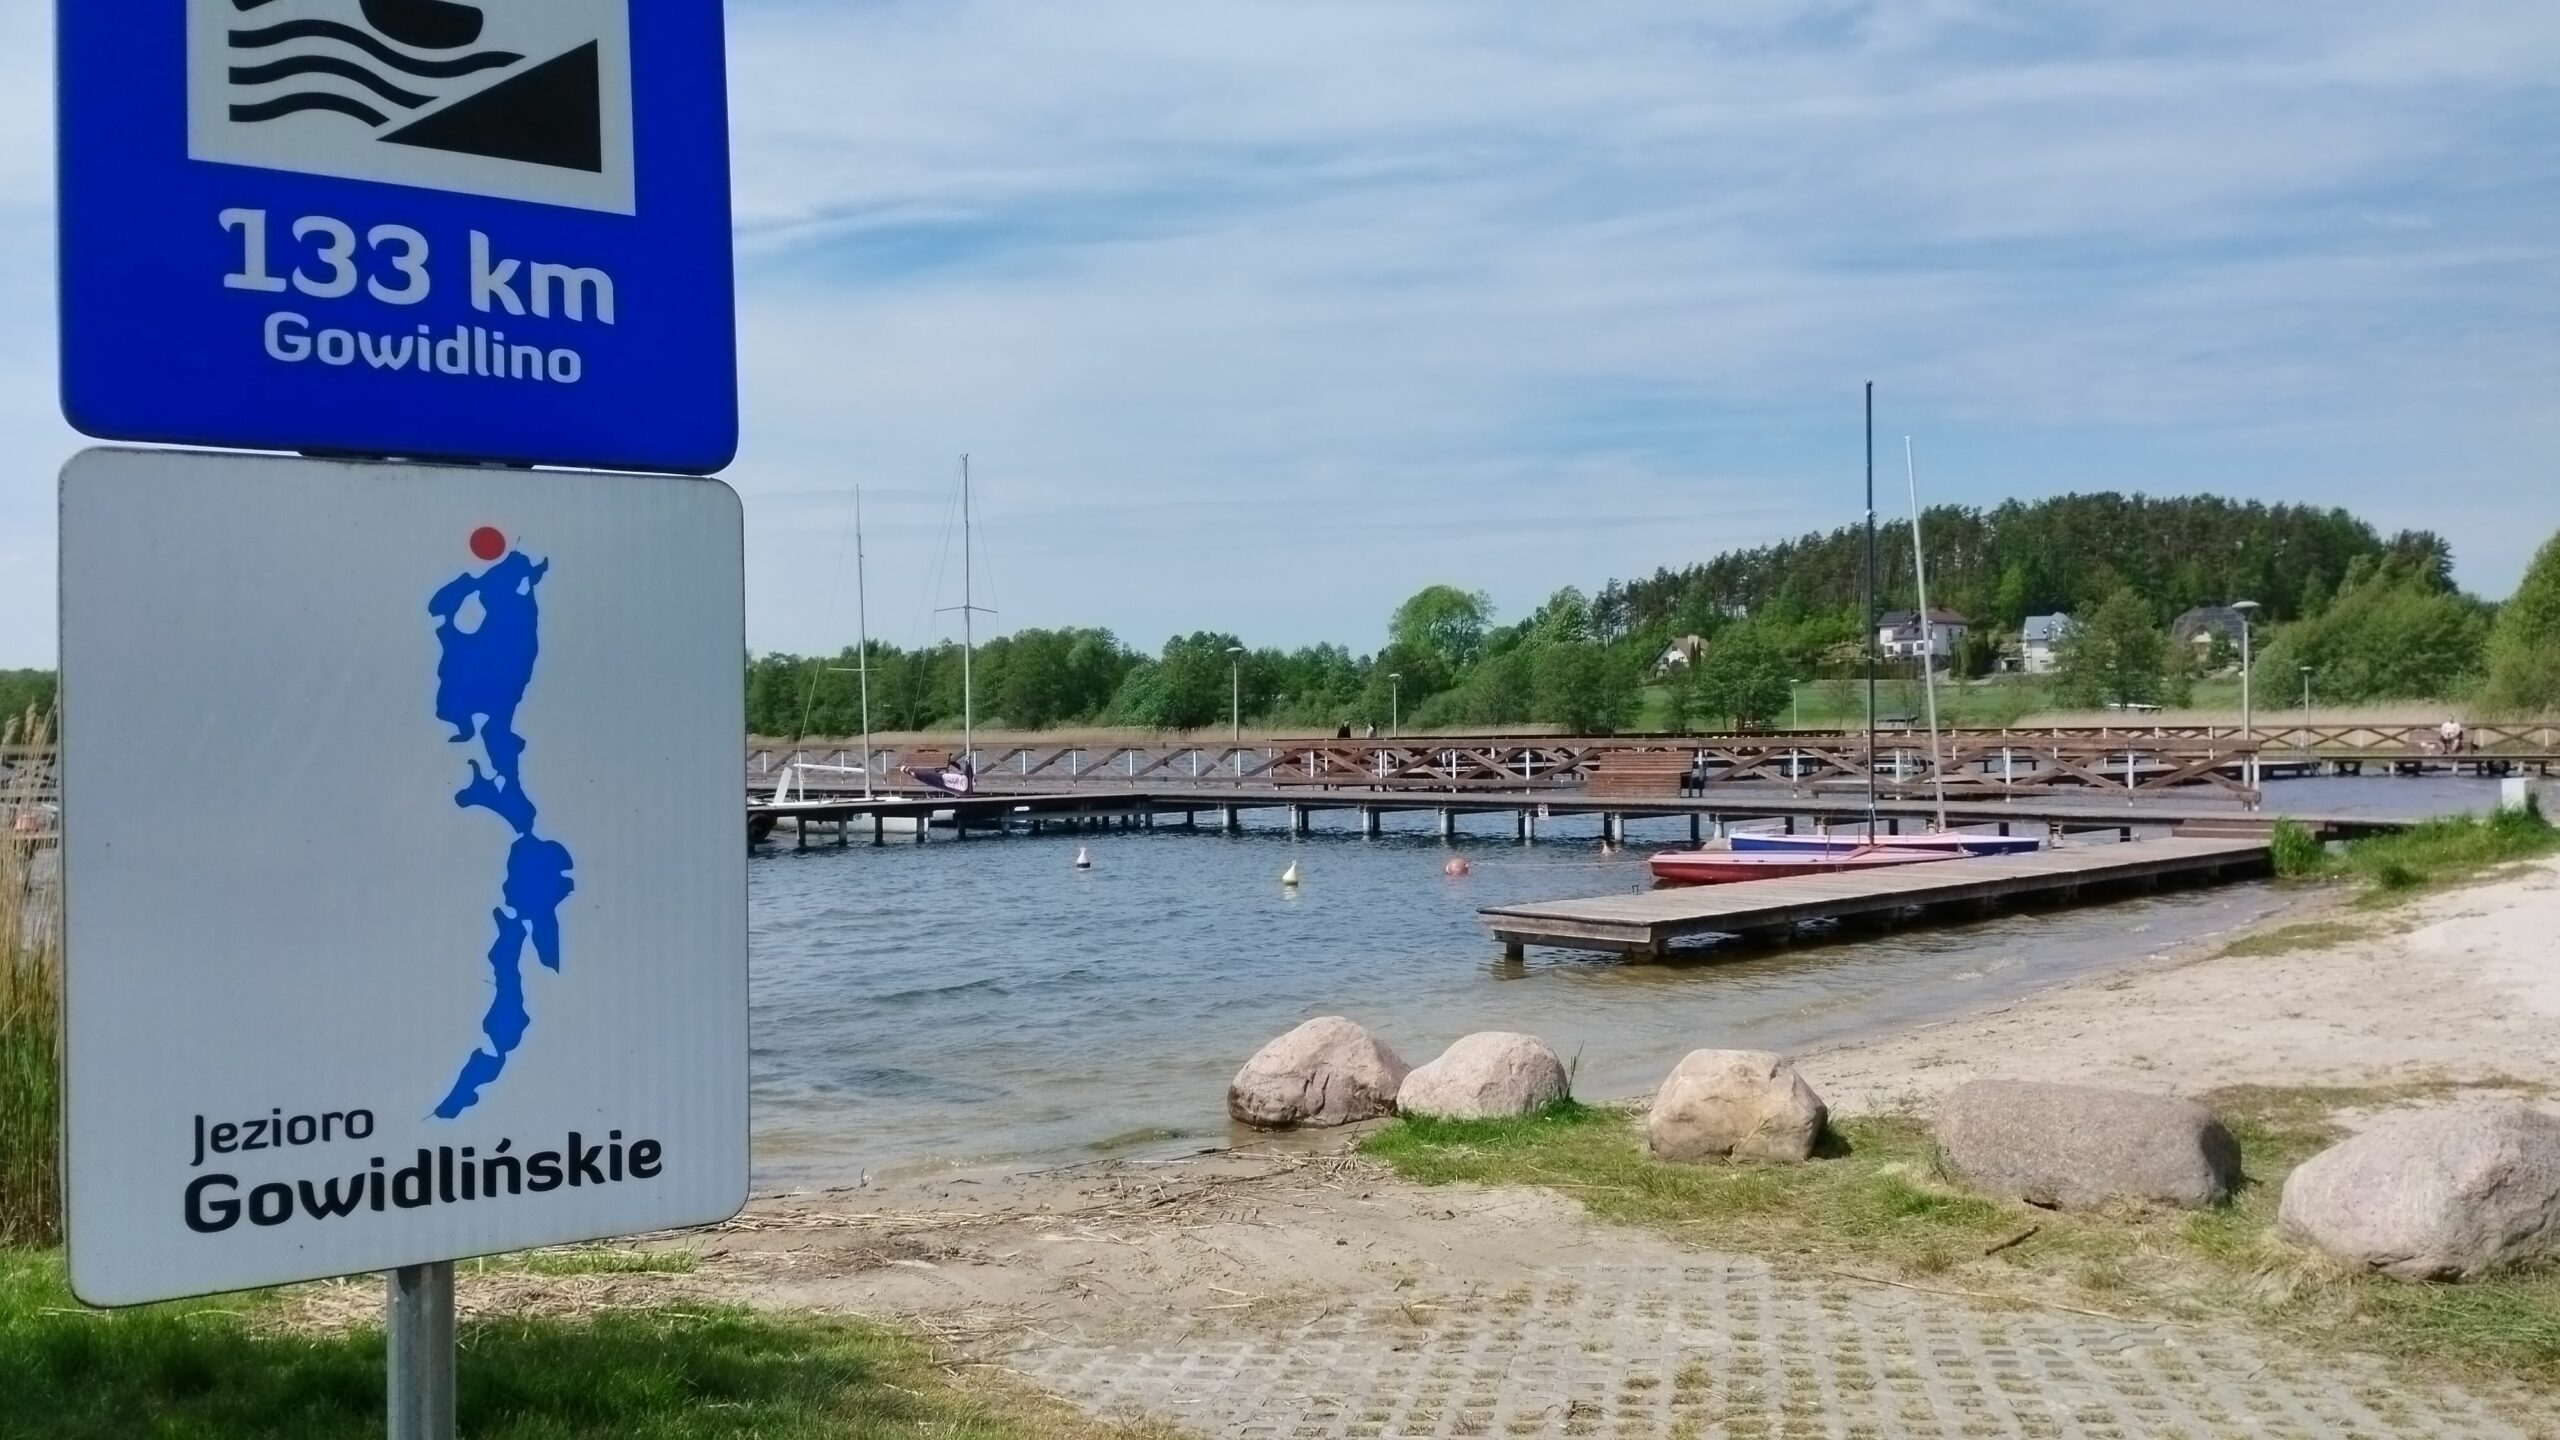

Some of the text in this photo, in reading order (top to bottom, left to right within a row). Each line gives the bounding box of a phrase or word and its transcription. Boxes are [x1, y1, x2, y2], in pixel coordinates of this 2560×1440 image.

[219, 208, 615, 325] 133 km
[264, 312, 582, 384] Gowidlino
[184, 1129, 663, 1234] Gowidlińskie
[189, 1107, 374, 1168] Jezioro
